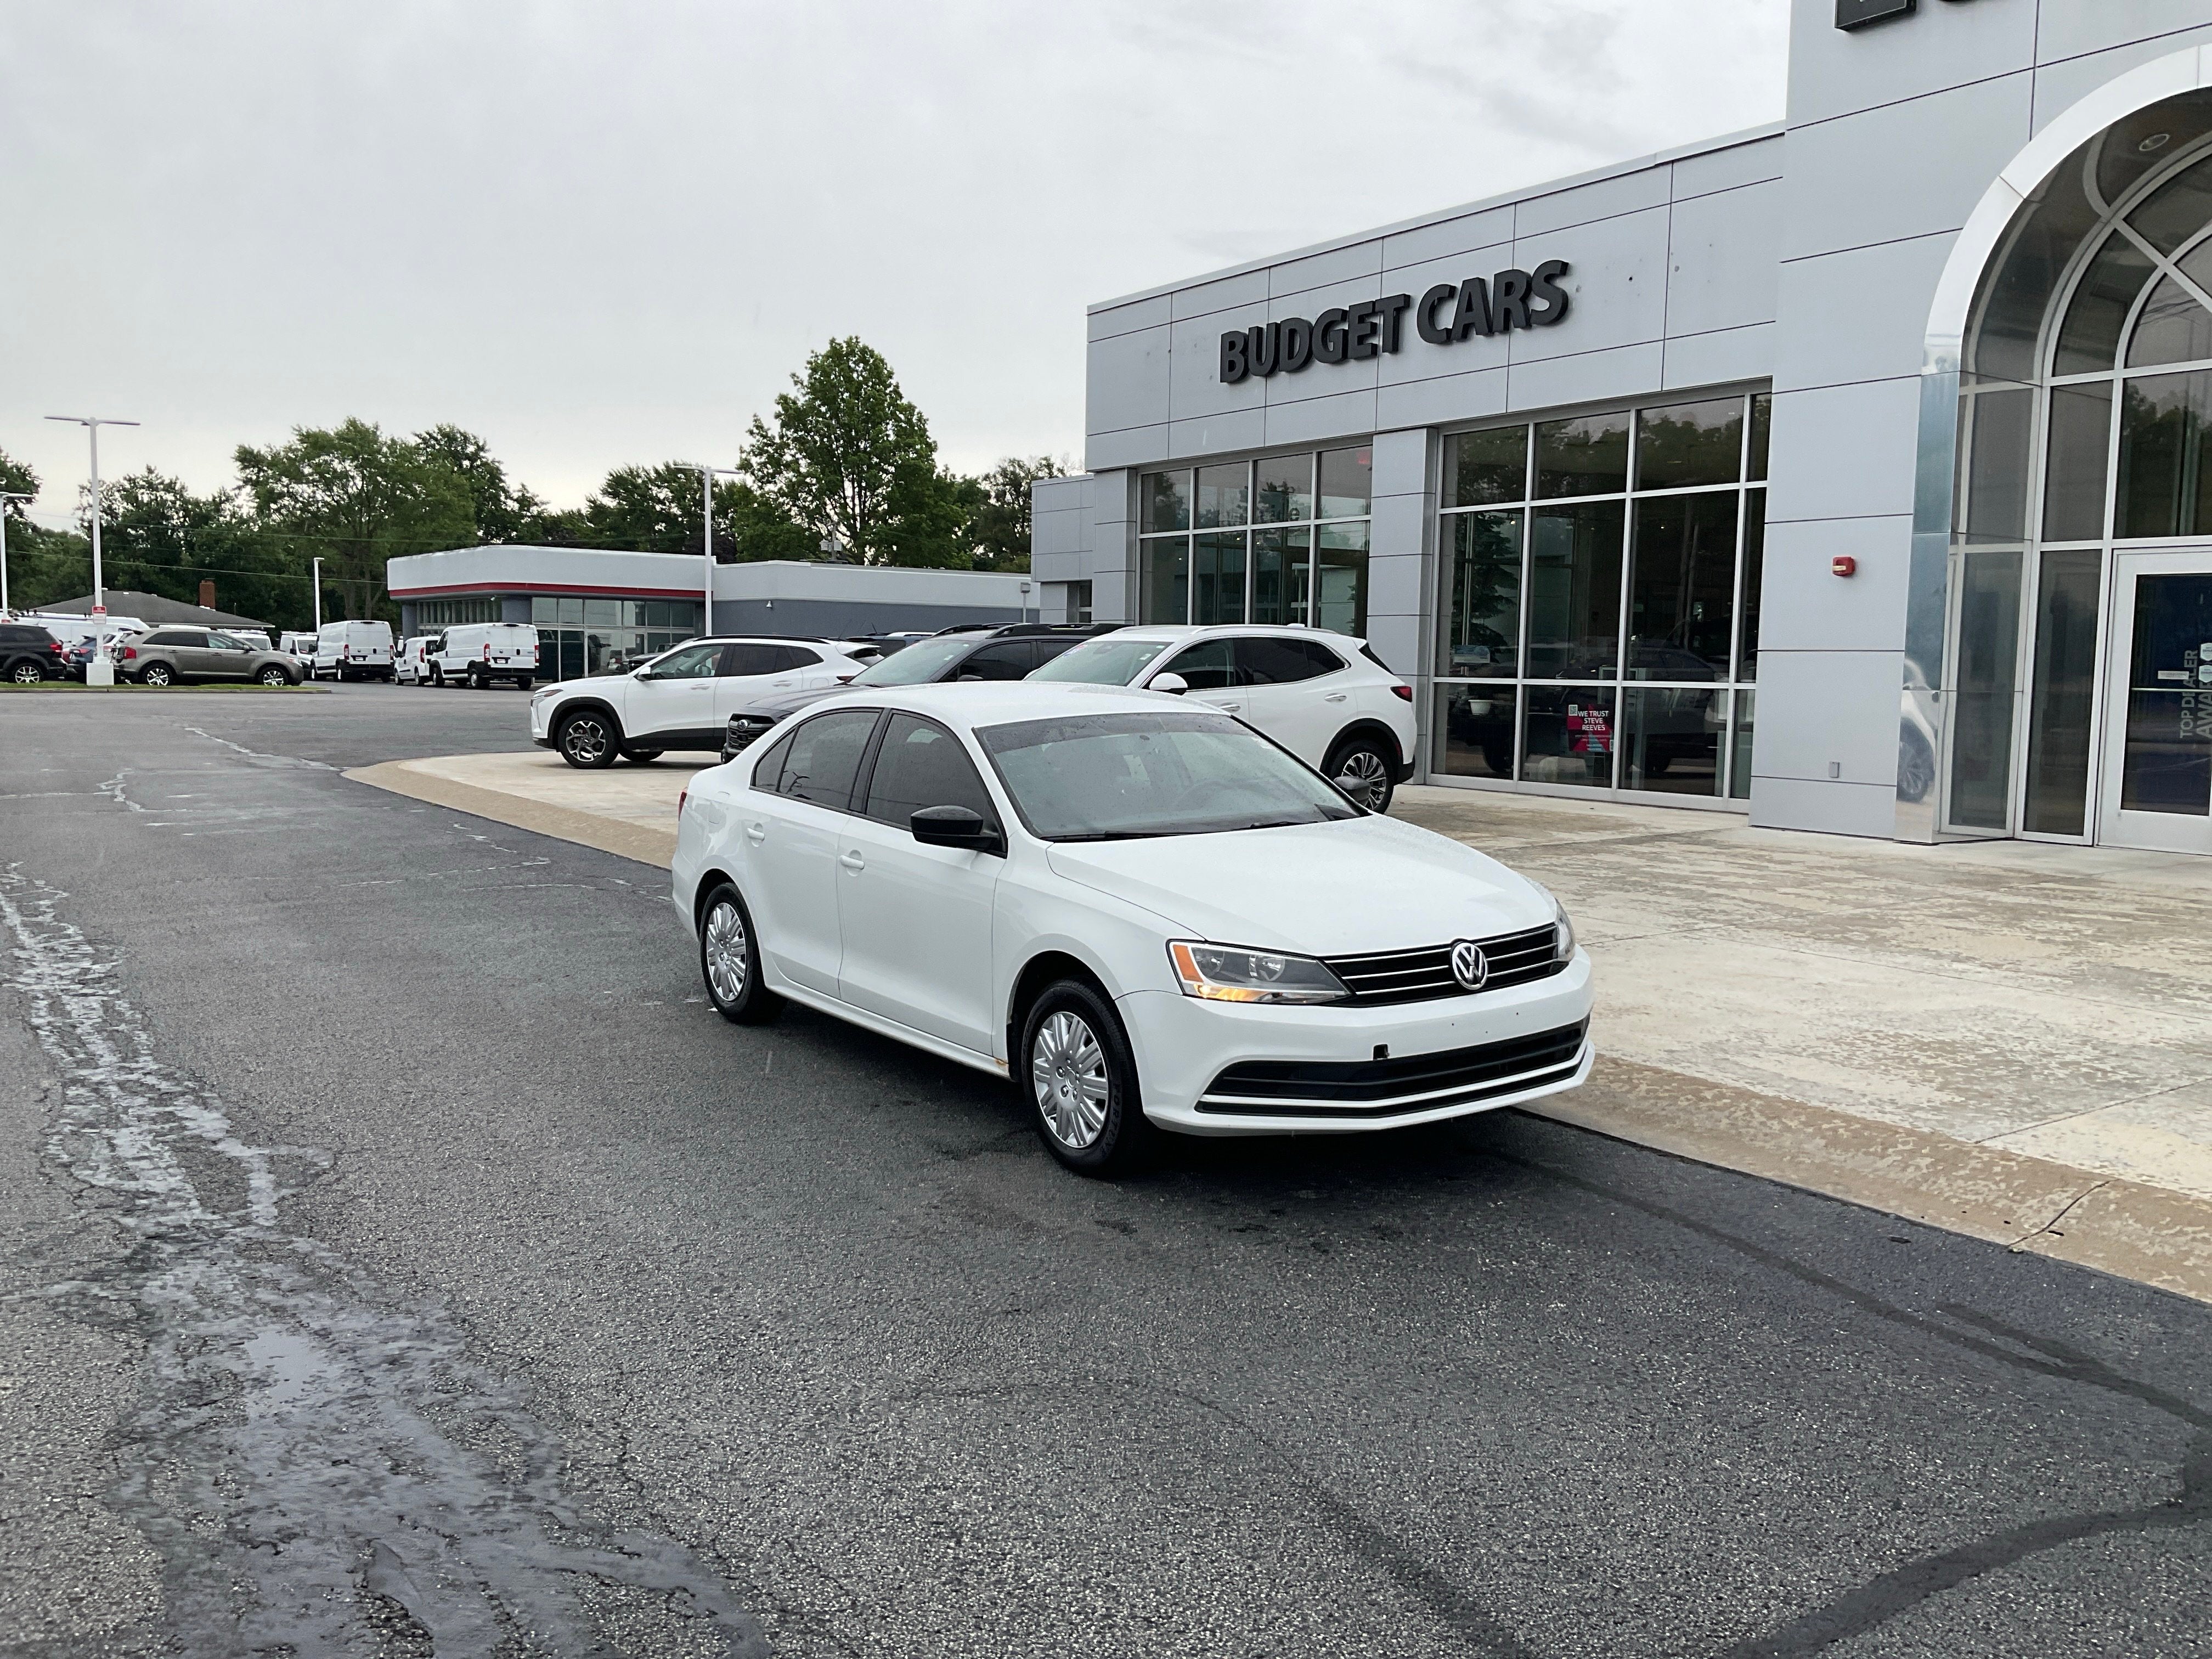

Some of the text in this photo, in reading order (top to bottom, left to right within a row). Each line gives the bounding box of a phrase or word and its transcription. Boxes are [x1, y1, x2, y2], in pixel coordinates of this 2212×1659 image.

[1220, 259, 1570, 383] BUDGET CARS
[2180, 710, 2194, 739] TOP
[1453, 943, 1487, 989] VW
